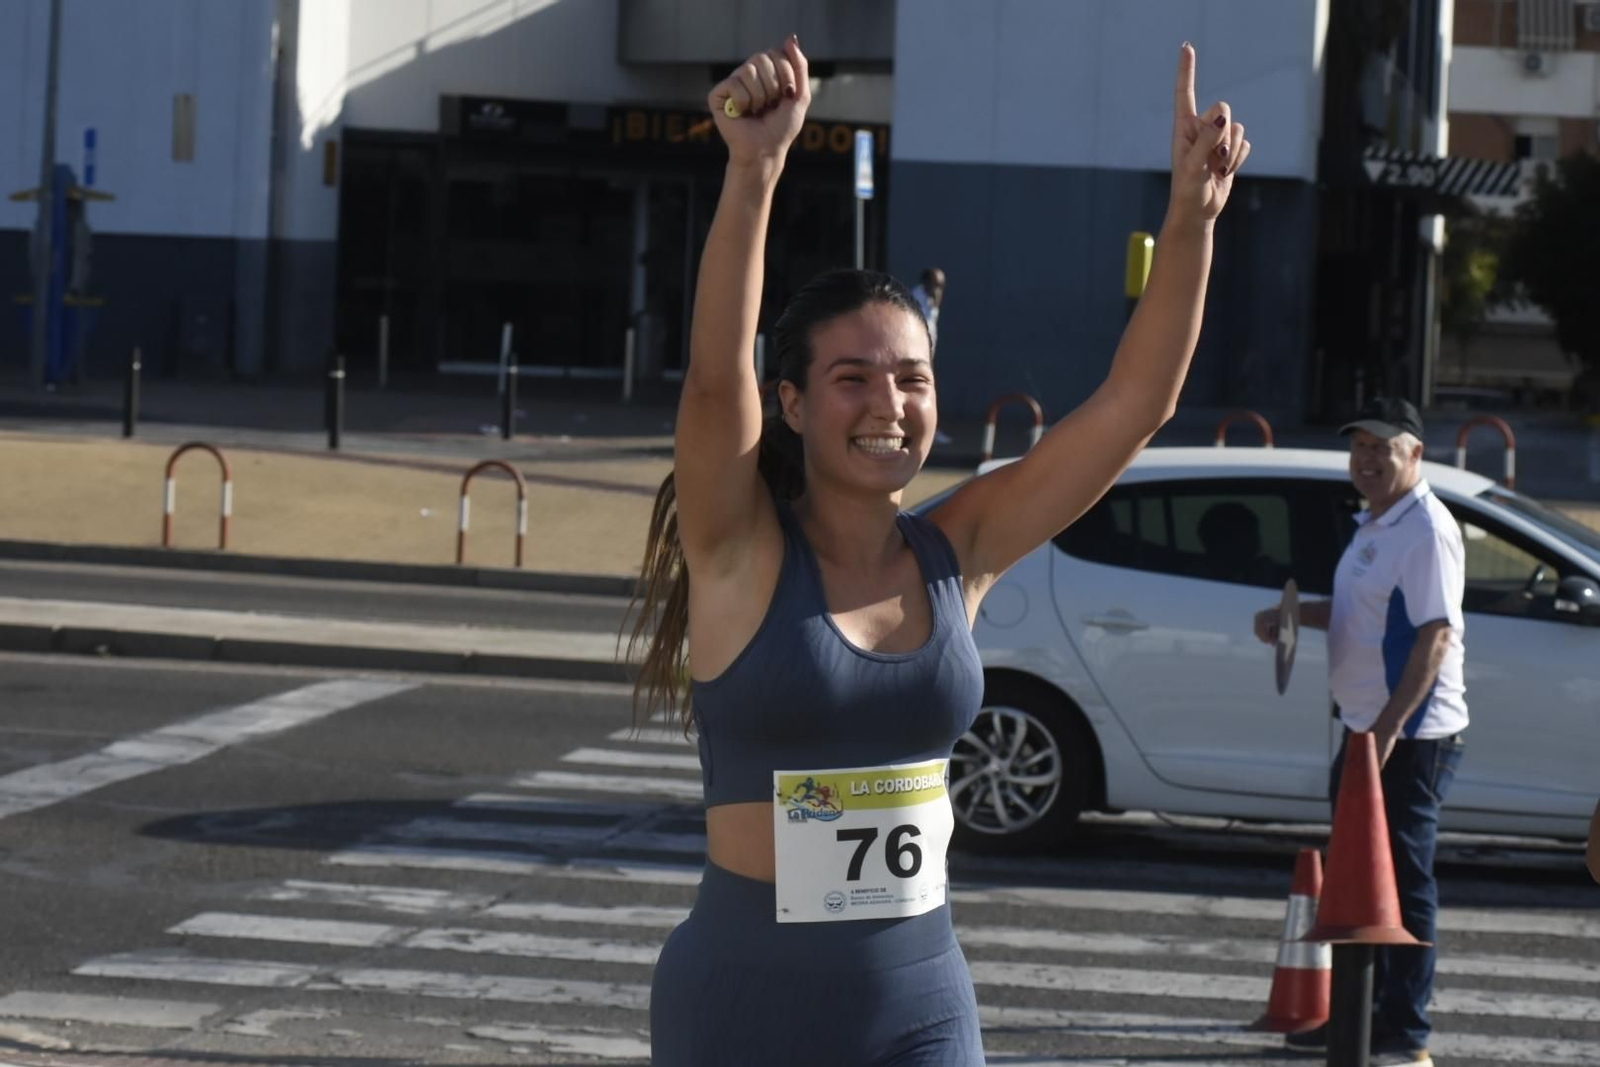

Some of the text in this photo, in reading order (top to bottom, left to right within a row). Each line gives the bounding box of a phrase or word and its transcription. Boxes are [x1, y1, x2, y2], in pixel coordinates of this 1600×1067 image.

[1386, 163, 1436, 187] 2.90
[851, 780, 870, 795] LA
[836, 824, 923, 882] 76
